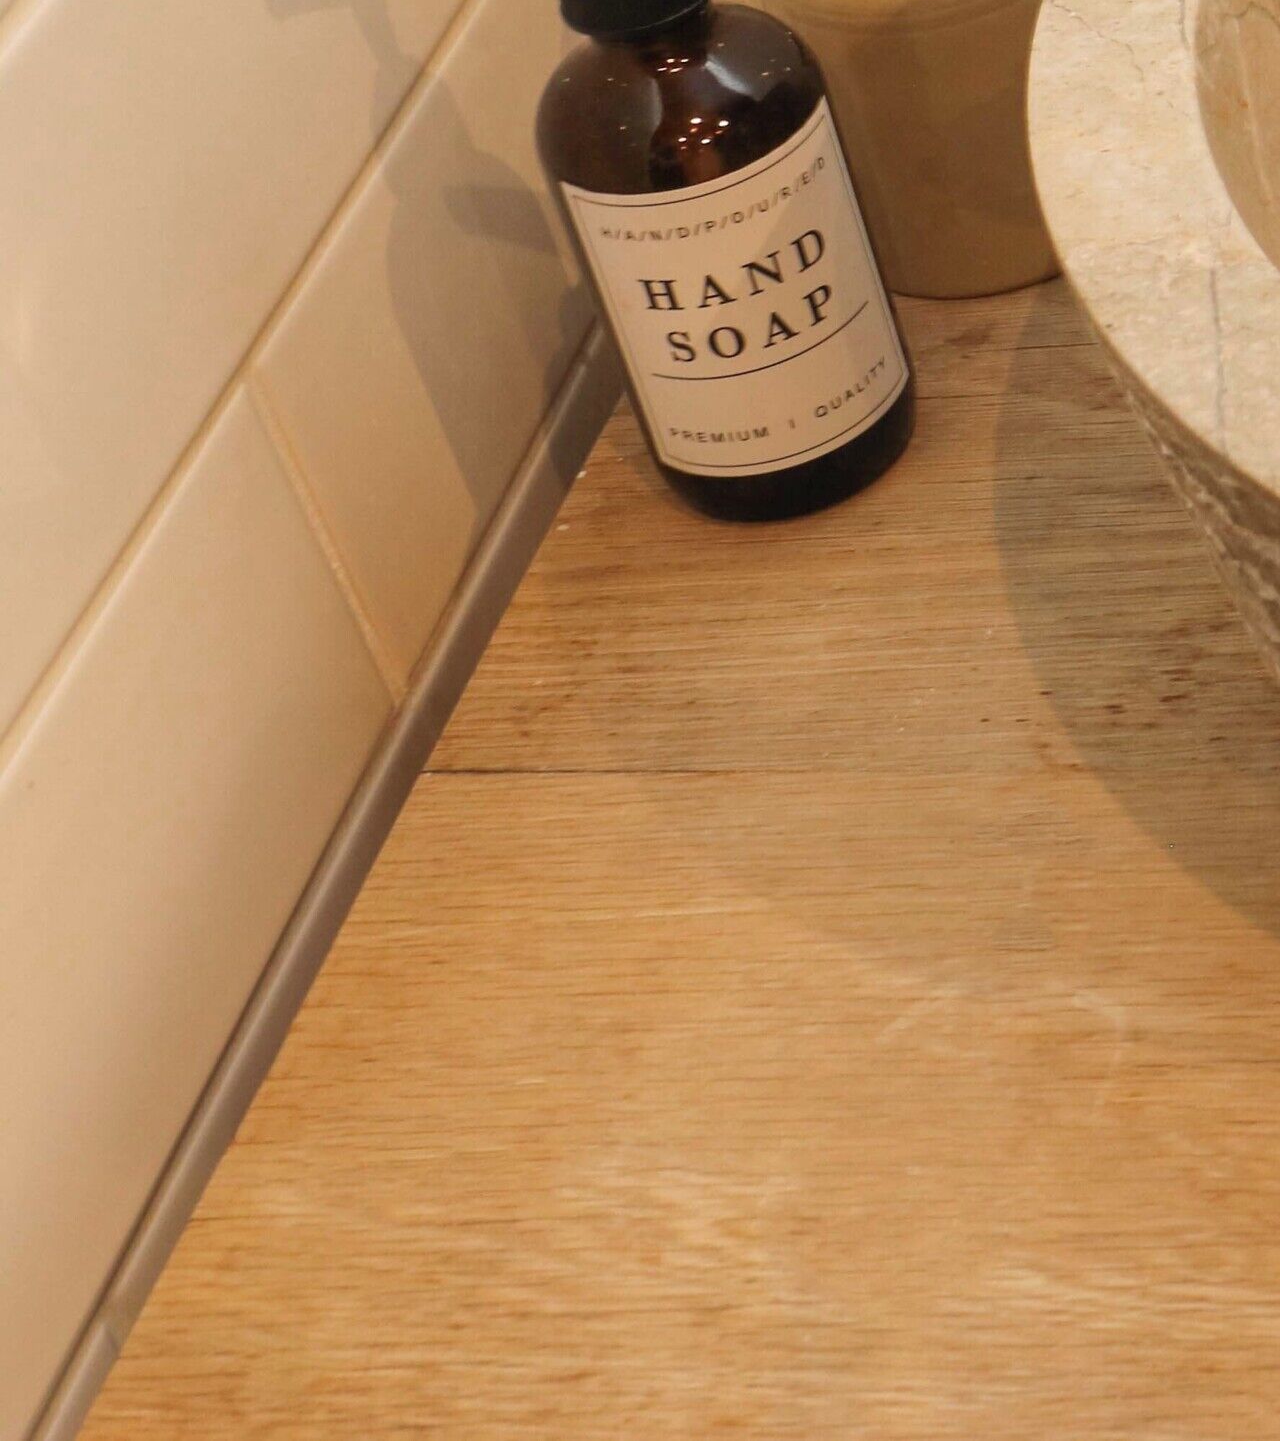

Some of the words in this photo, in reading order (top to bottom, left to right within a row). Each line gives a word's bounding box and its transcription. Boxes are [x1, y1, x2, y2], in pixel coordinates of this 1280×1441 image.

[638, 229, 826, 311] HAND
[666, 284, 833, 363] SOAP
[669, 426, 770, 444] PREMIUM
[814, 356, 887, 419] QUALITY
